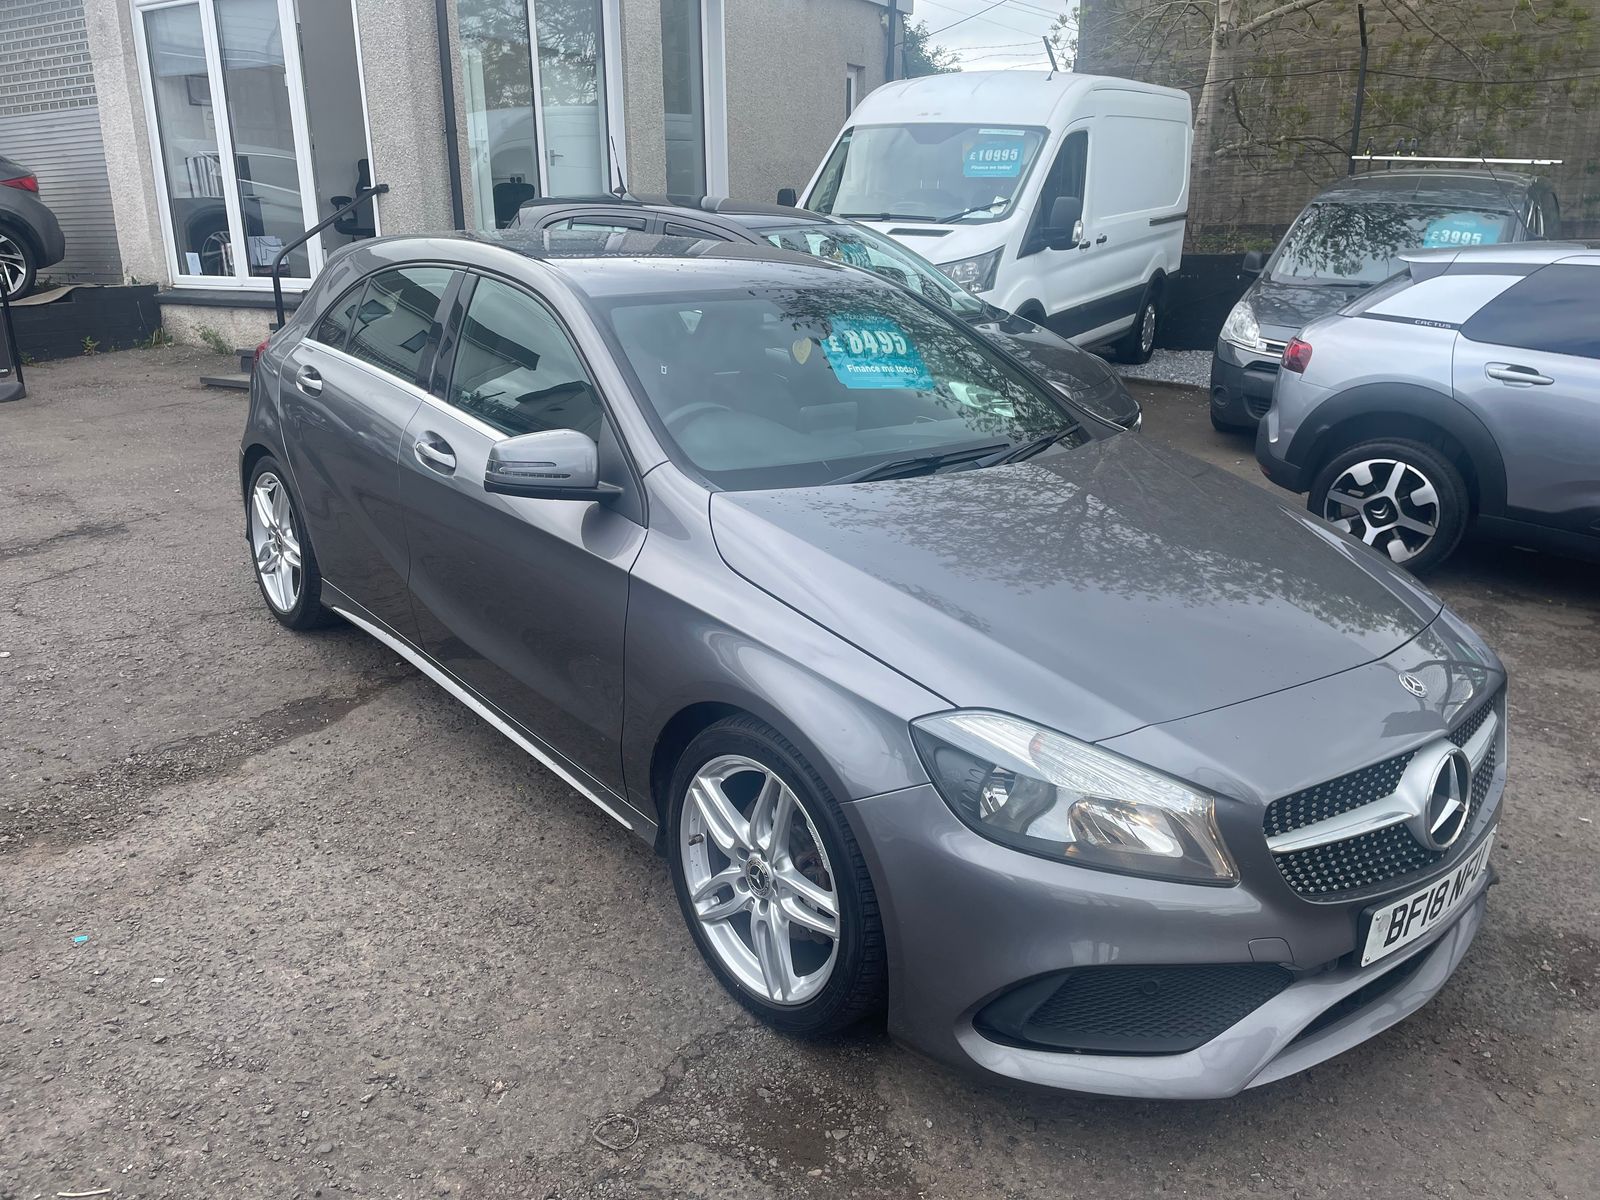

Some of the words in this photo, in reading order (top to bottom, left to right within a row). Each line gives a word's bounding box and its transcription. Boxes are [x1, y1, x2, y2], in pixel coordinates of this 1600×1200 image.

[1414, 319, 1451, 329] CACTUS
[846, 364, 880, 374] Finance
[881, 364, 895, 374] me
[1384, 879, 1450, 948] BF18
